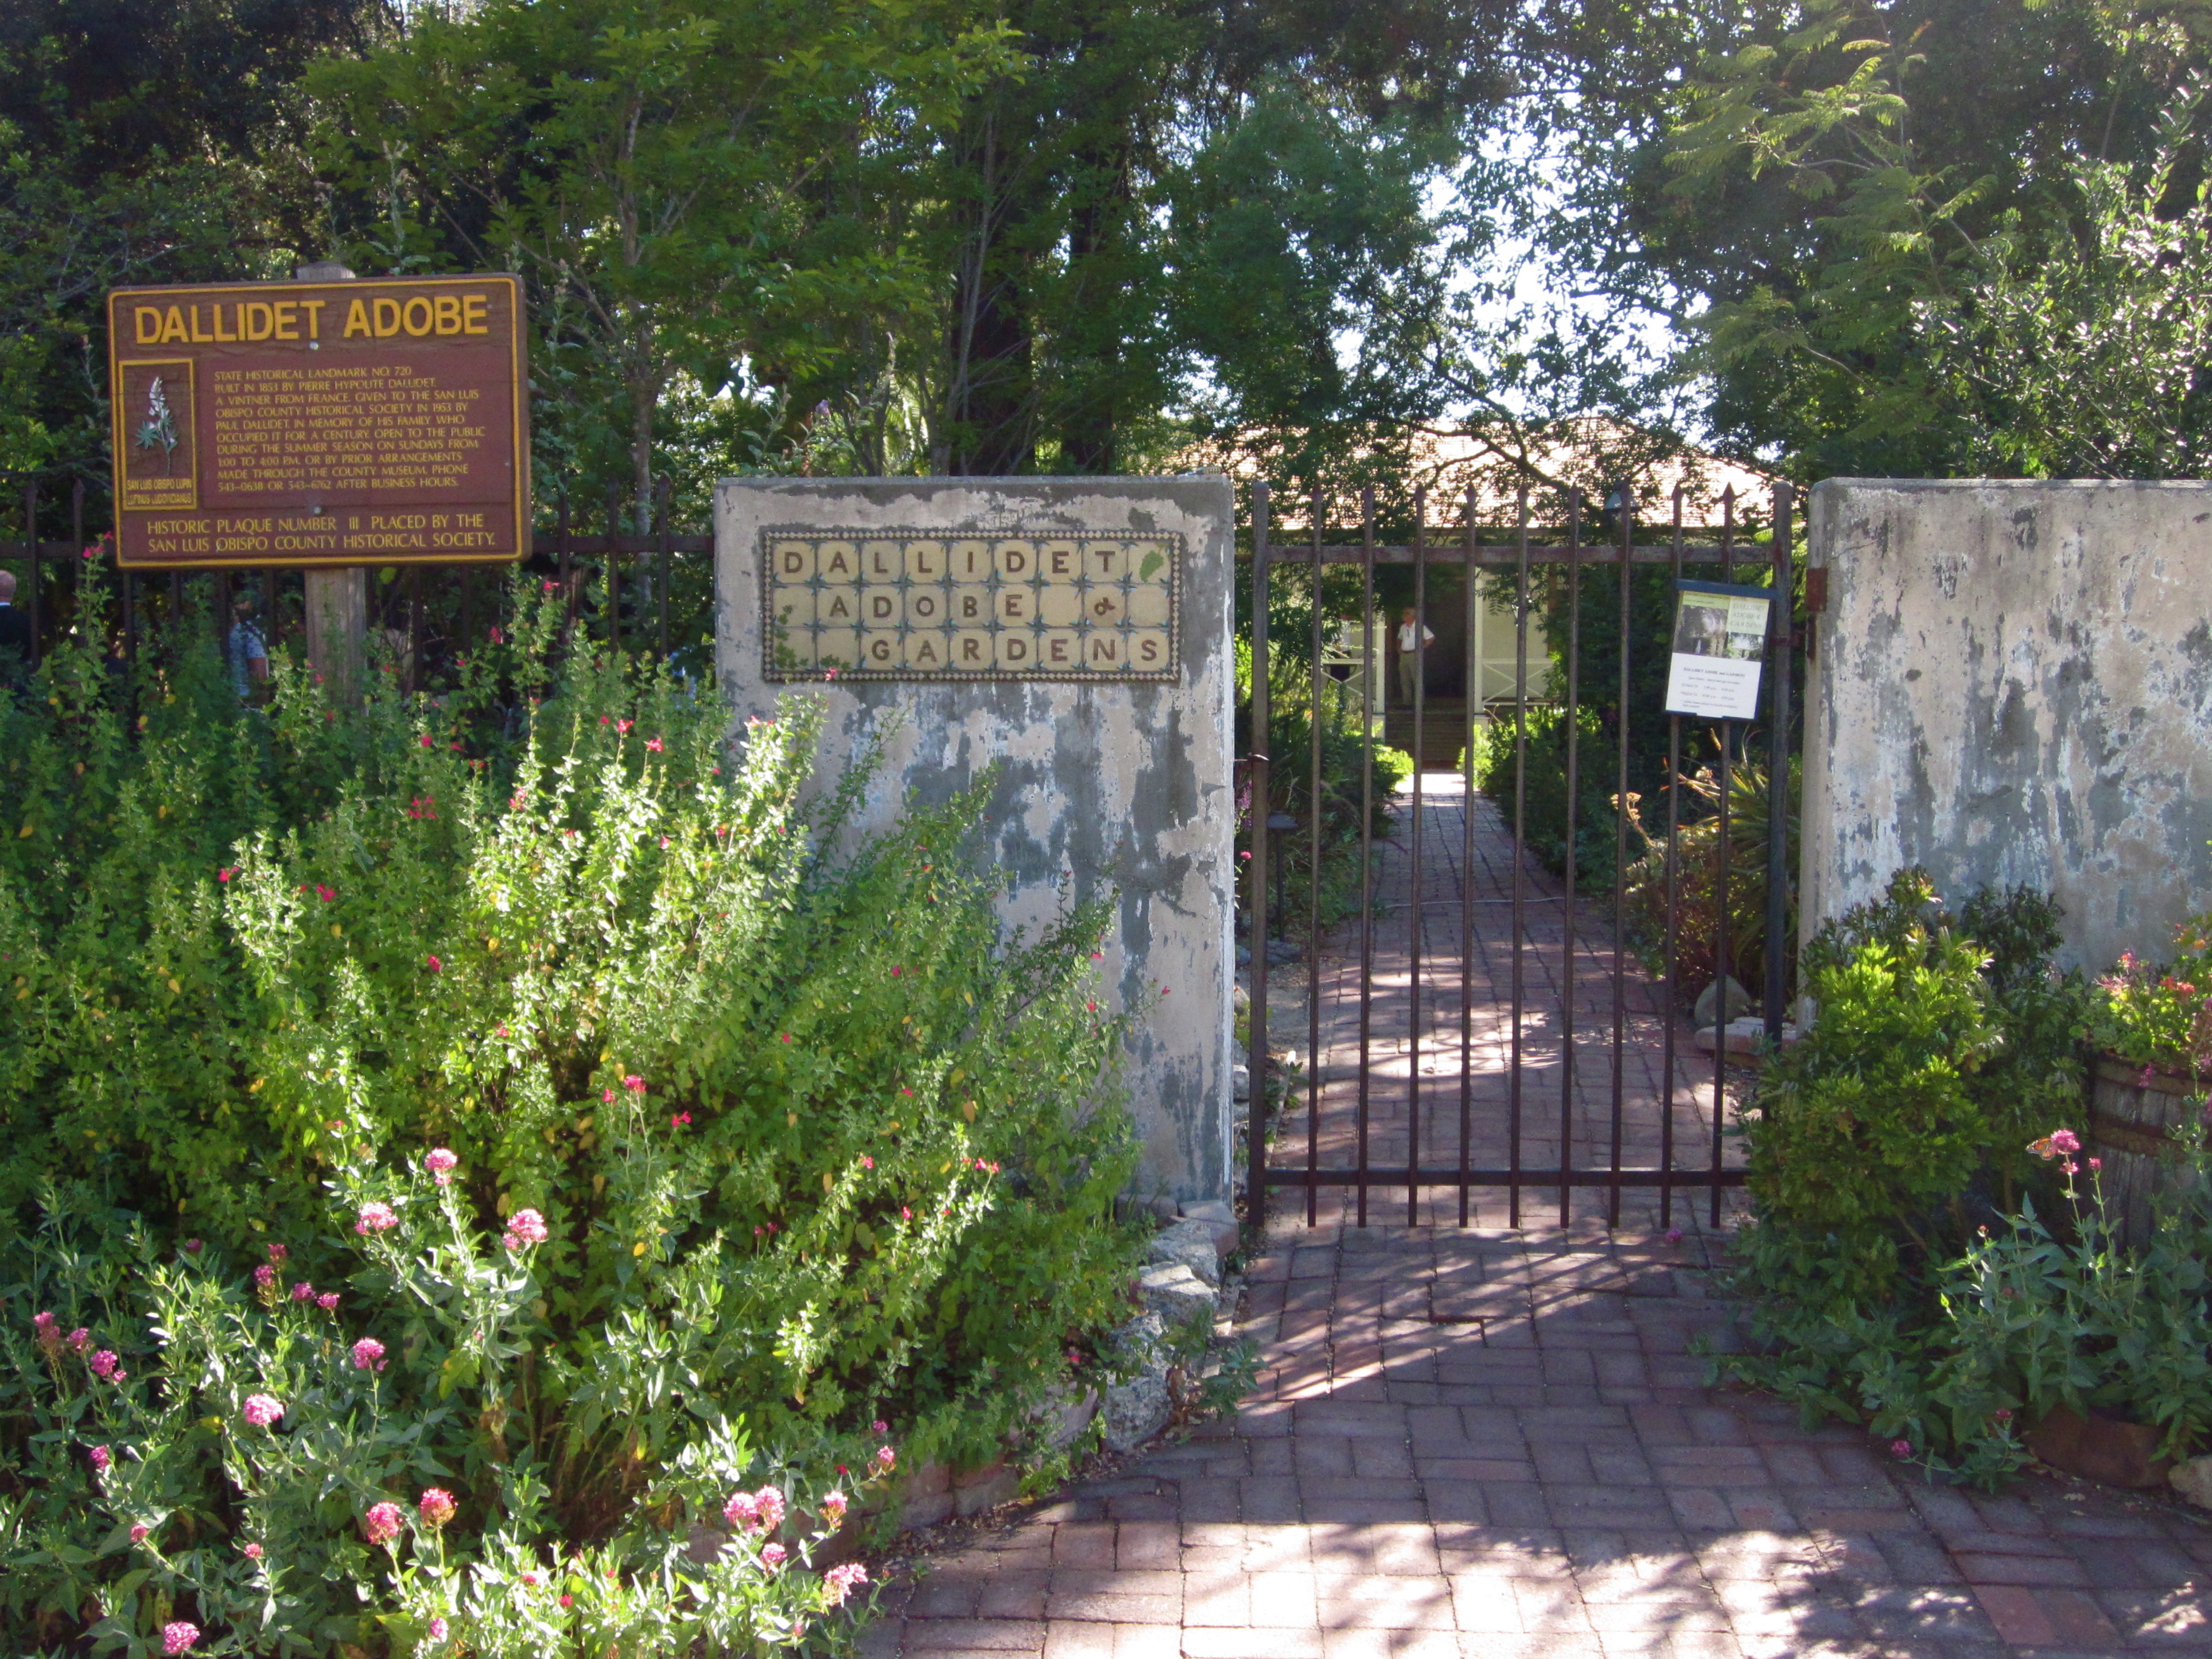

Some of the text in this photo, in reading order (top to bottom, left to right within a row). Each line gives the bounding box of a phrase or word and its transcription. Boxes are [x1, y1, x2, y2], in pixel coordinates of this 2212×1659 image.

[135, 295, 487, 344] DALLIDET ADOBE
[215, 371, 241, 380] STATE
[246, 369, 304, 380] HISTORICAL
[308, 367, 367, 378] LANDMARK
[395, 366, 411, 376] 720
[215, 383, 240, 392] BUILT
[244, 383, 255, 391] IN
[259, 383, 278, 391] 1853
[282, 382, 294, 391] BY
[299, 380, 330, 390] PIERRE
[216, 396, 224, 405] A
[228, 395, 270, 405] VINTNER
[275, 394, 305, 403] FROM
[355, 392, 386, 401] GIVEN
[391, 391, 405, 400] TO
[411, 390, 430, 400] THE
[434, 390, 456, 399] SAN
[458, 390, 479, 399] LUIS
[216, 402, 467, 417] OBISPO COUNTY HISTORICAL SOCIETY IN 1953 BY
[216, 421, 238, 430] PAUL
[294, 419, 305, 428] IN
[309, 417, 353, 428] MEMORY
[359, 417, 373, 426] OF
[377, 417, 393, 426] HIS
[397, 415, 430, 425] FAMILY
[436, 415, 465, 424] WHO
[216, 432, 268, 442] OCCUPIED
[273, 431, 281, 440] IT
[285, 431, 305, 440] FOR
[310, 431, 319, 440] A
[374, 428, 403, 438] OPEN
[407, 428, 423, 437] TO
[426, 427, 445, 437] THE
[451, 427, 484, 436] PUBLIC
[217, 438, 478, 453] DURING THE SUMMER SEASON ON SUNDAYS FROM
[241, 457, 255, 465] TO
[259, 457, 279, 466] 4:00
[305, 455, 320, 464] OR
[325, 454, 337, 464] BY
[341, 453, 372, 463] PRIOR
[379, 452, 462, 463] ARRANGEMENTS
[218, 469, 247, 479] MADE
[253, 468, 304, 477] THROUGH
[309, 467, 327, 476] THE
[332, 466, 376, 476] COUNTY
[432, 464, 468, 474] PHONE
[267, 481, 283, 489] OR
[337, 479, 367, 488] AFTER
[371, 477, 416, 487] BUSINESS
[148, 520, 211, 534] HISTORIC
[217, 518, 272, 535] PLAQUE
[279, 518, 336, 531] NUMBER
[372, 515, 426, 530] PLACED
[433, 515, 448, 527] BY
[457, 514, 483, 527] THE
[149, 531, 495, 552] SAN LUIS OBISPO COUNTY HISTORICAL SOCIETY.
[784, 550, 1115, 574] DALLIDET
[829, 594, 1116, 618] ADOBE &
[871, 638, 1157, 662] GARDENS
